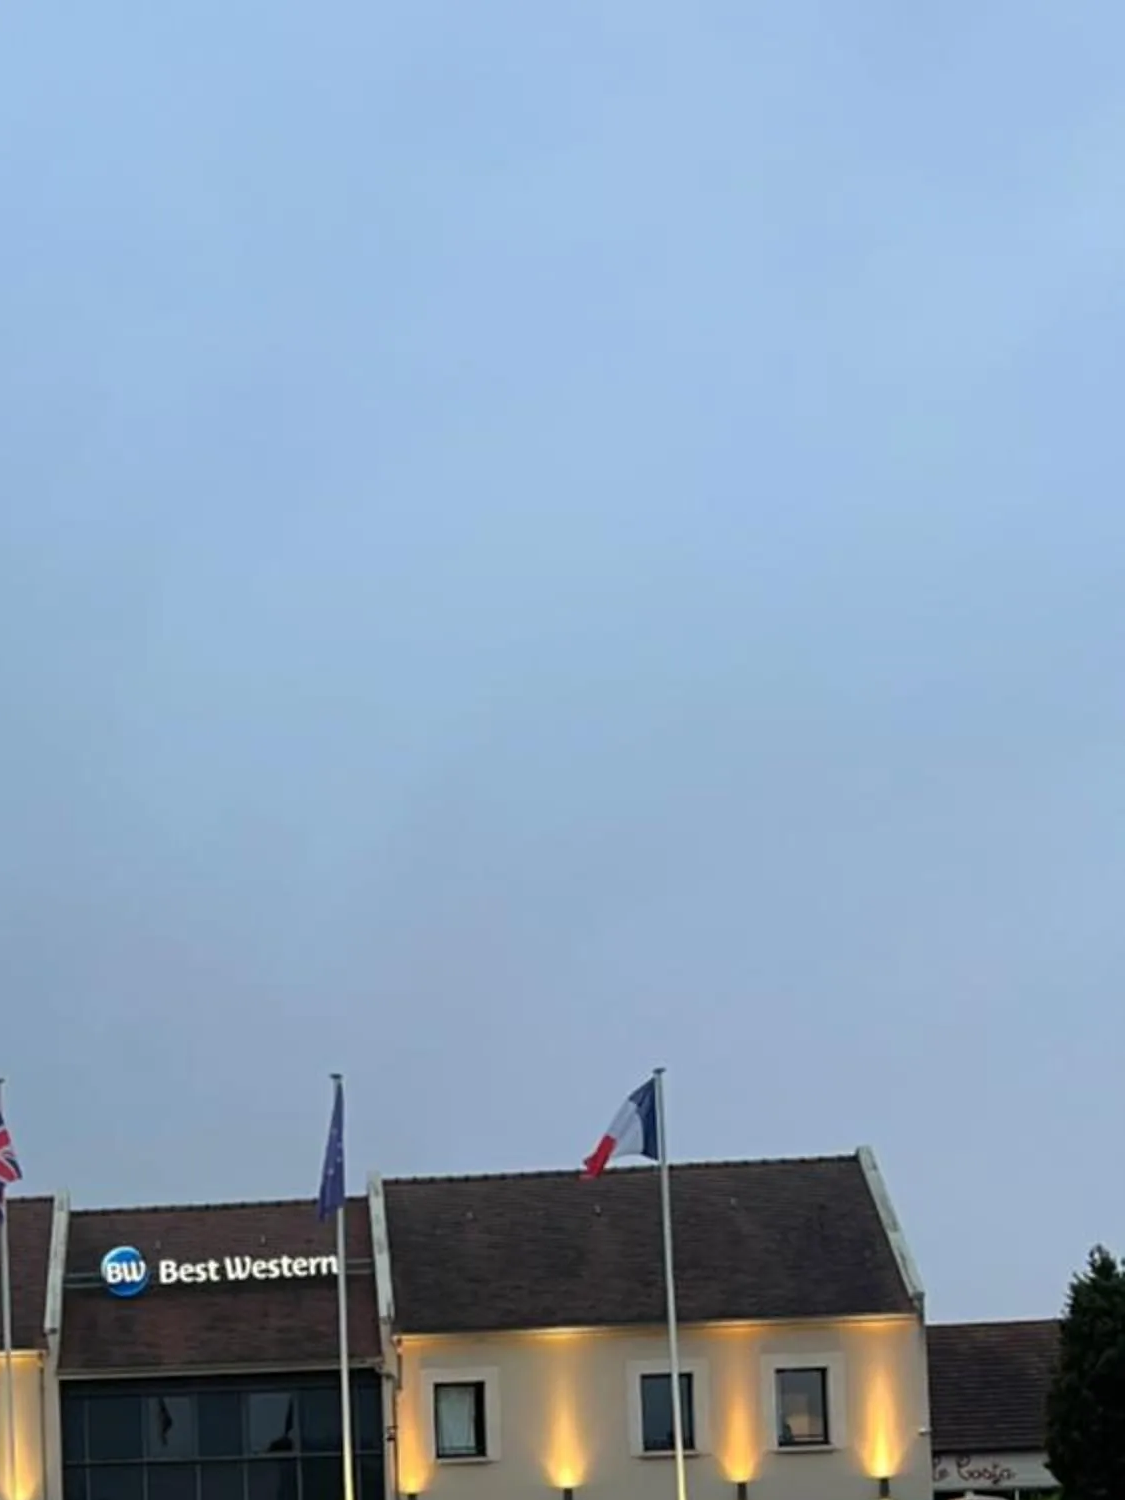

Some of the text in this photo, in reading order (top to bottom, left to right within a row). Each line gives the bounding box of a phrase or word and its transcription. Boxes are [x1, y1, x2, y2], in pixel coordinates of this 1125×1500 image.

[106, 1259, 147, 1284] BW
[159, 1254, 339, 1284] Best Western
